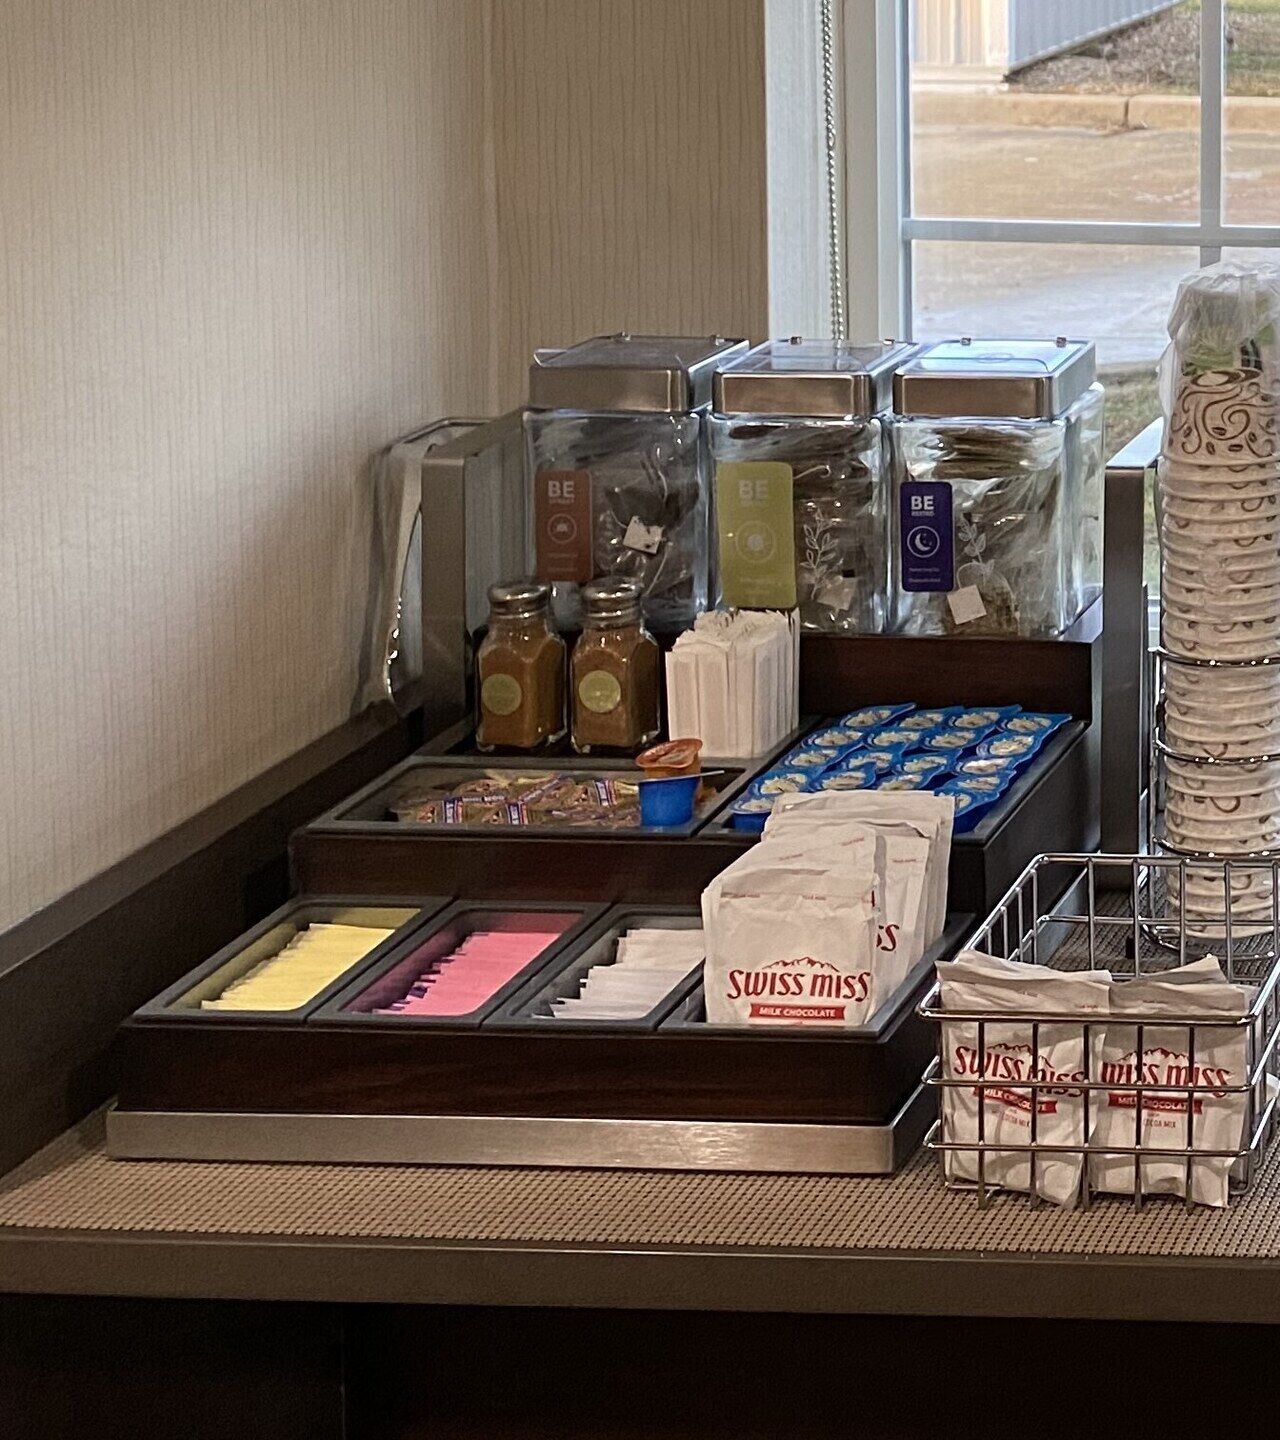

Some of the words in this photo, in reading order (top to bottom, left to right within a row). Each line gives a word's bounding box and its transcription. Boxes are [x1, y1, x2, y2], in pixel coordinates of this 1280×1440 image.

[547, 480, 576, 498] BE
[738, 479, 769, 498] BE
[910, 495, 935, 510] BE
[727, 969, 805, 999] SWISS
[759, 1007, 781, 1016] MILK
[783, 1008, 836, 1018] CHOCOLATE
